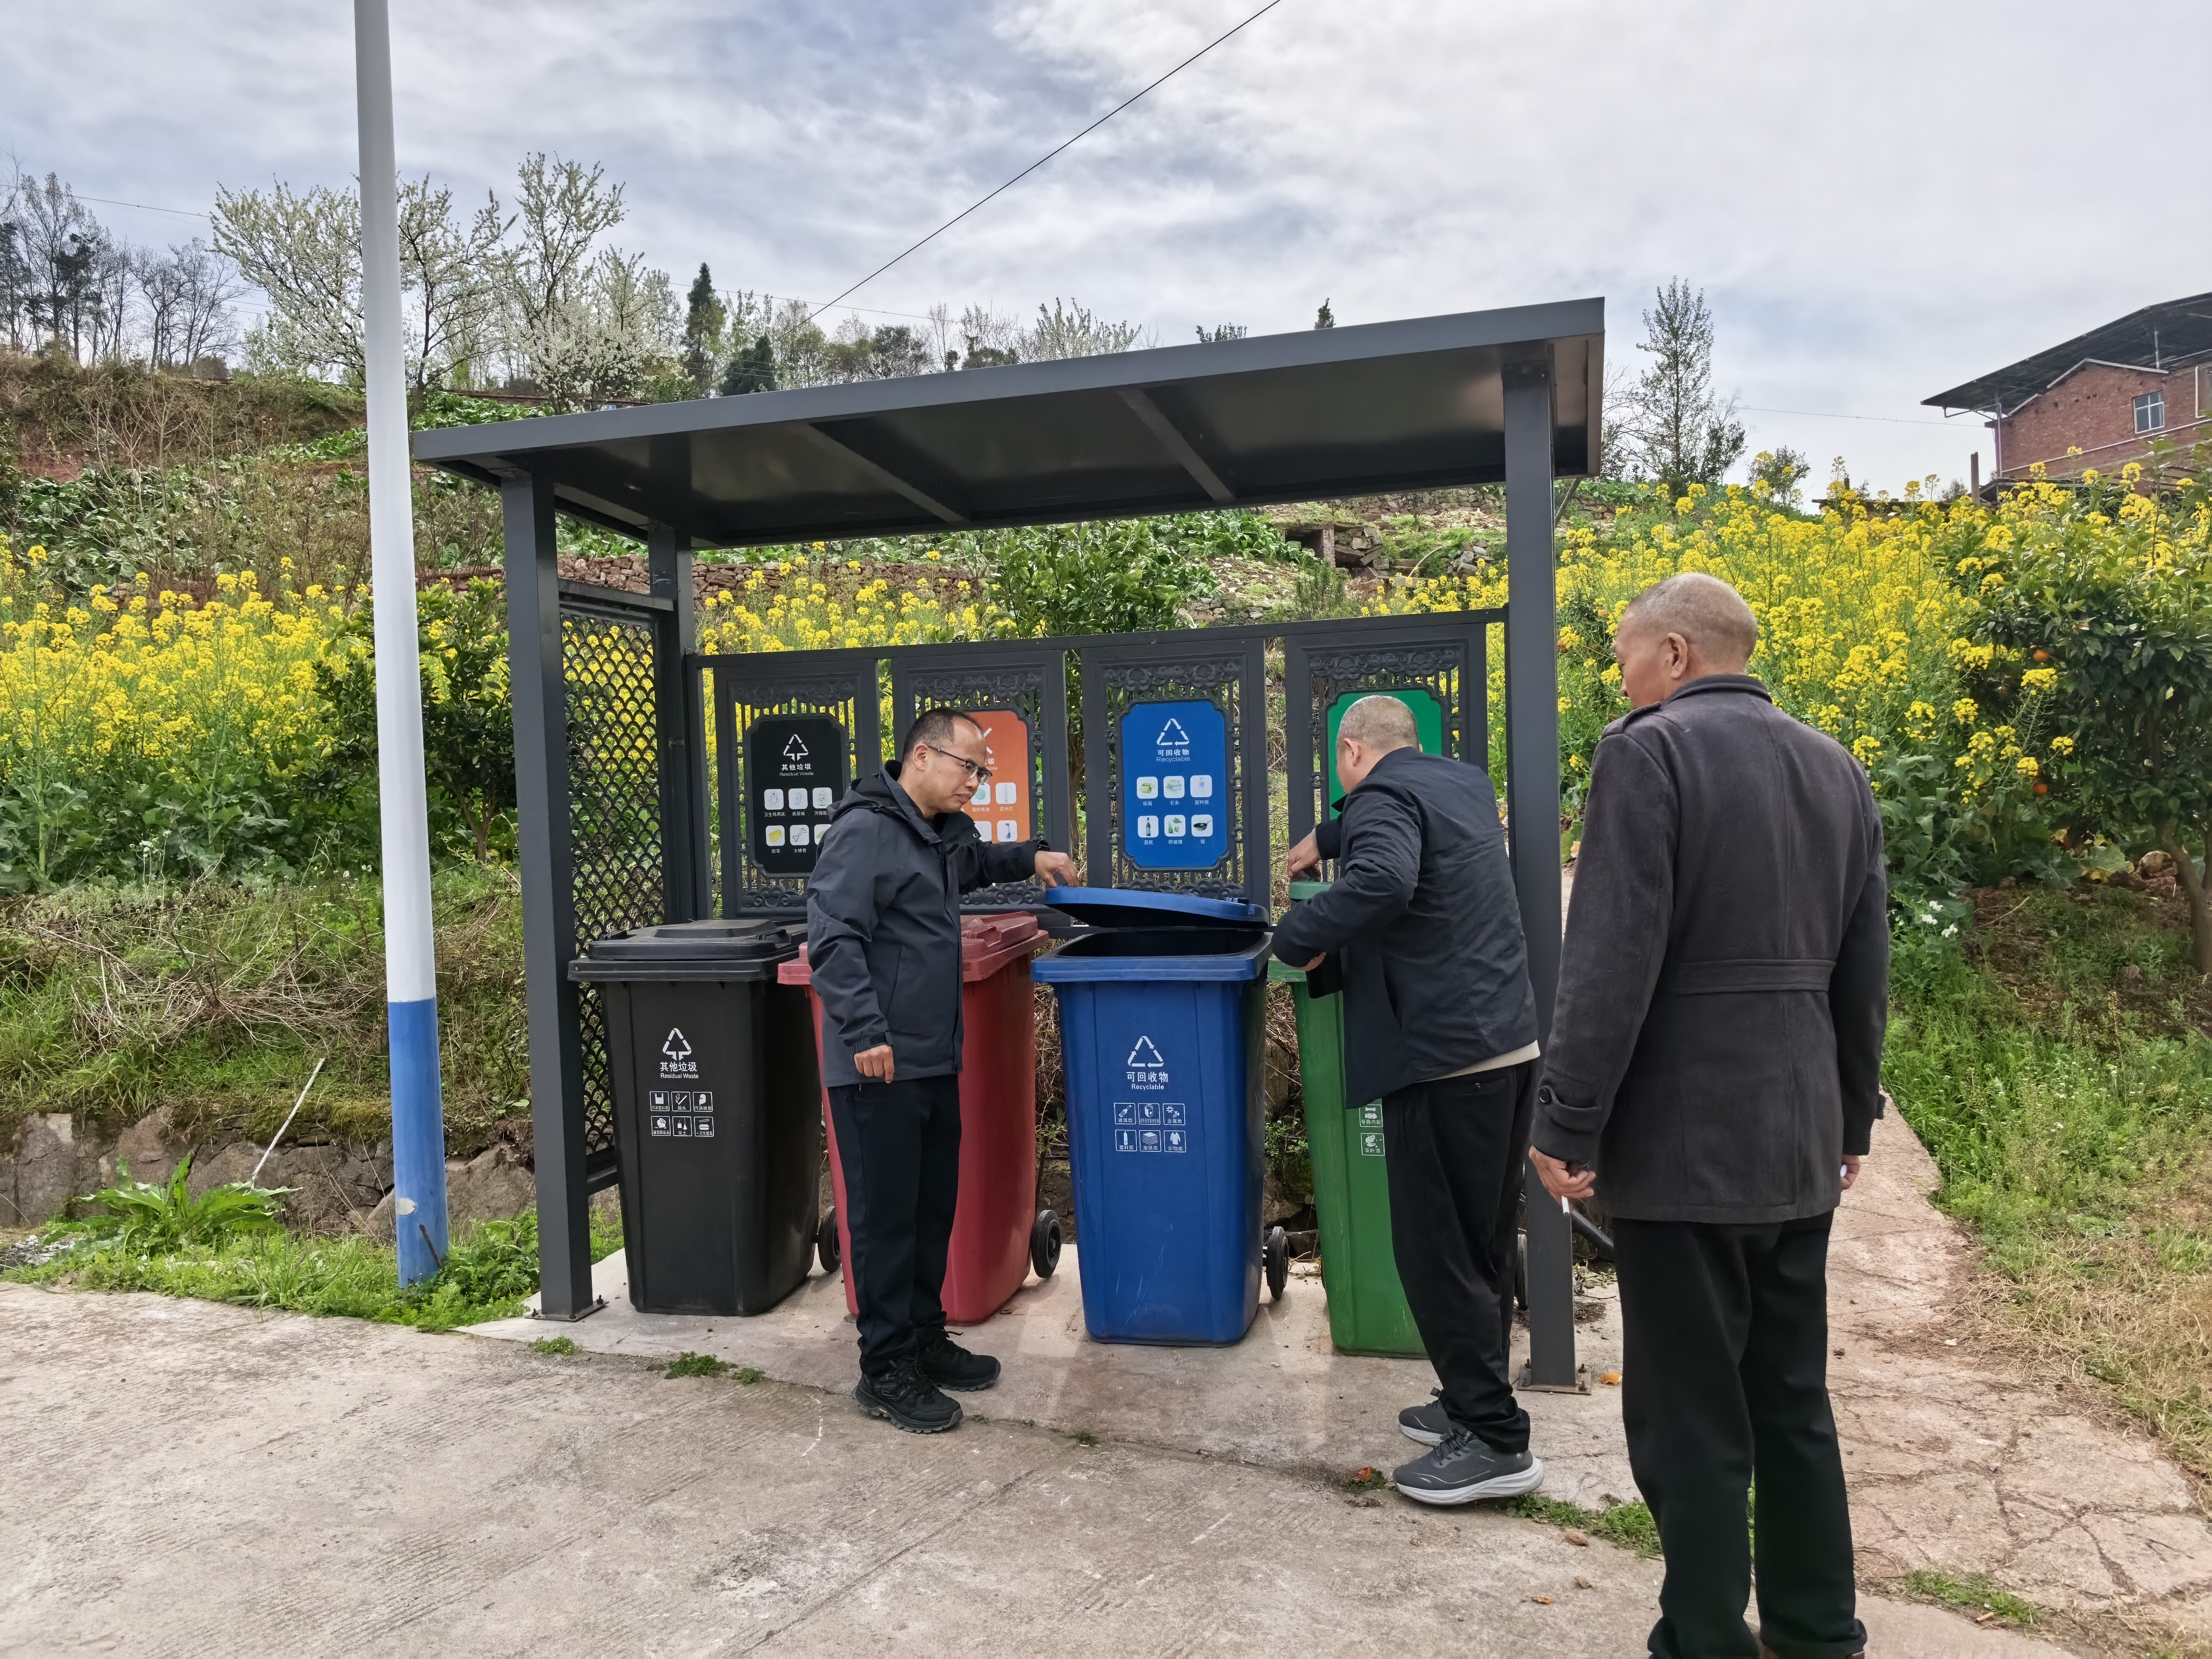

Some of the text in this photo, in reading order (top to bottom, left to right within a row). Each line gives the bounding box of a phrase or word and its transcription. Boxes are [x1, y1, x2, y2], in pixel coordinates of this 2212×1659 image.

[1157, 748, 1190, 757] 可回收物
[660, 1061, 697, 1072] 其他垃圾
[1127, 1071, 1168, 1083] 可回收物
